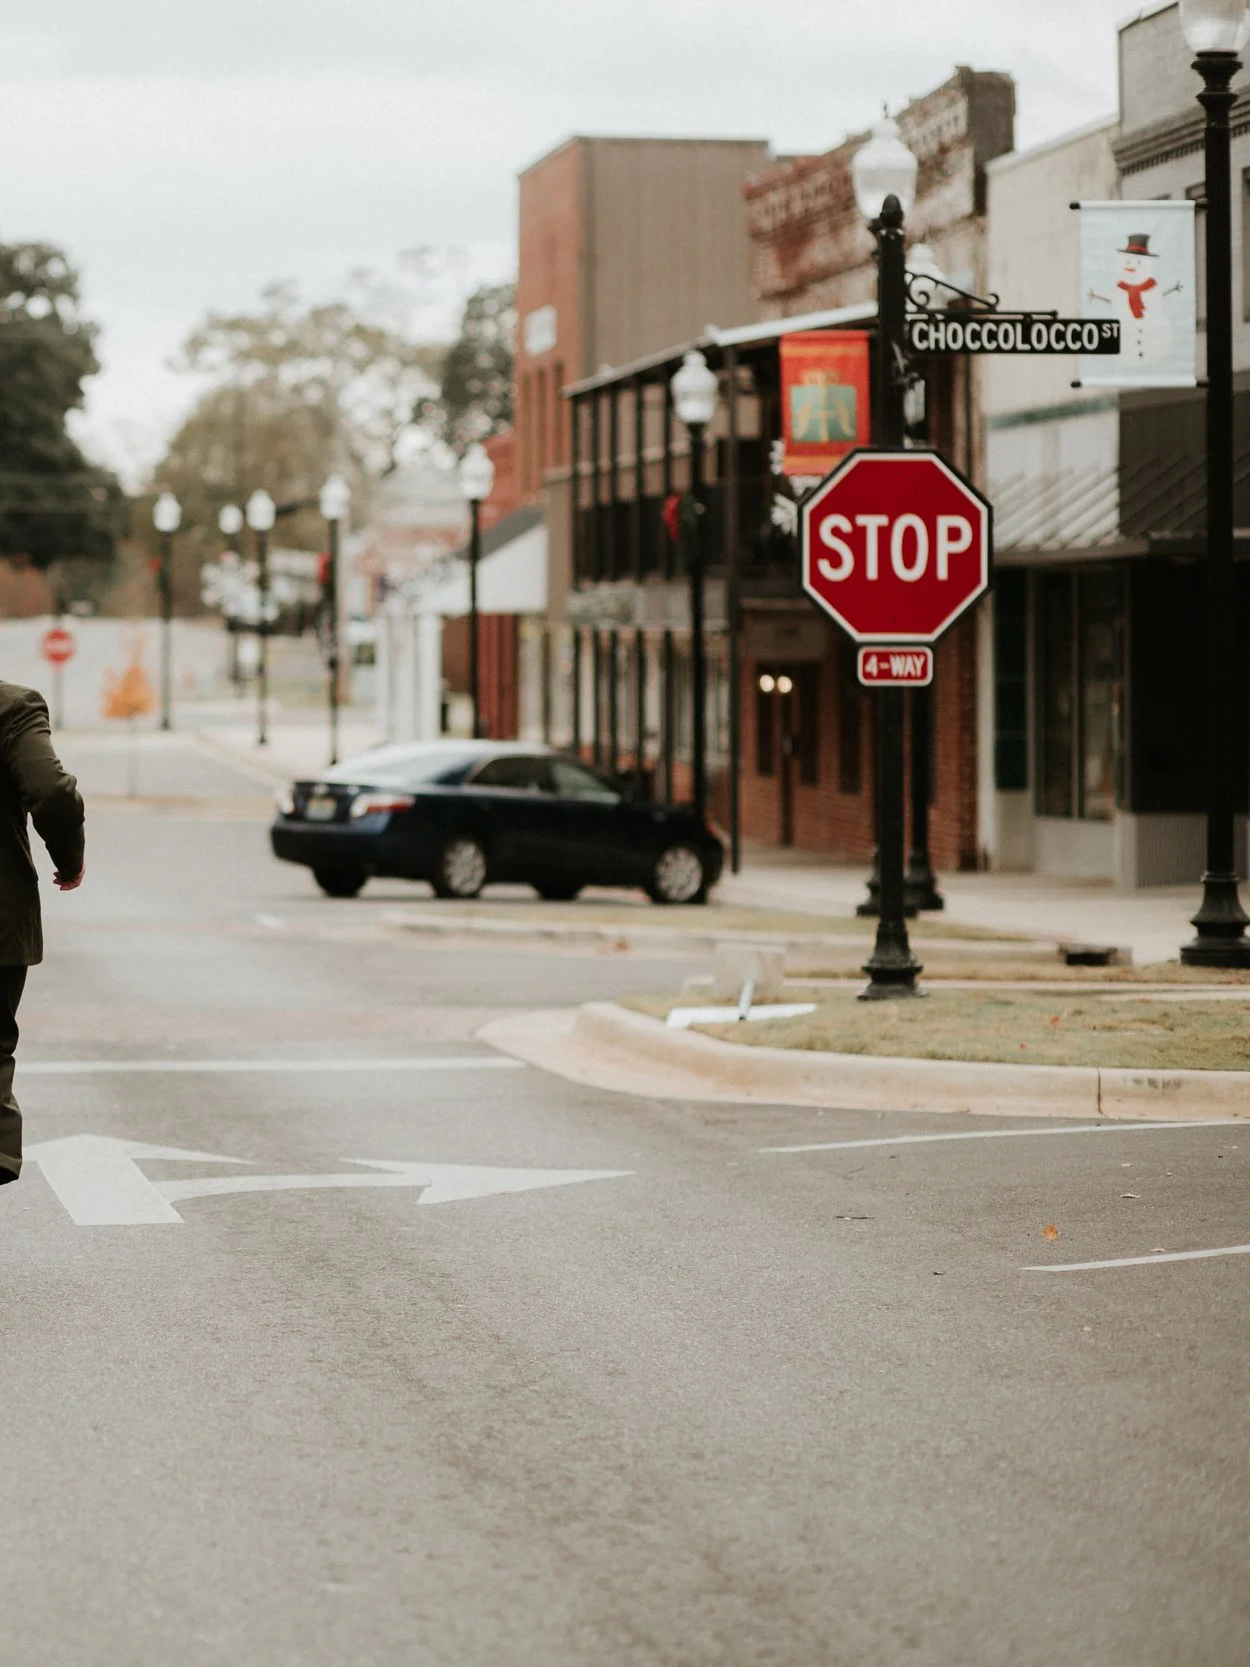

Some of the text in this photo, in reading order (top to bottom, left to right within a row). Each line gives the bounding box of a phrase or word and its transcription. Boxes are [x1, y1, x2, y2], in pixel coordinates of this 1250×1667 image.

[911, 321, 1120, 351] CHOCCOLOCCO ST
[816, 513, 973, 583] STOP
[864, 653, 925, 678] 4-WAY
